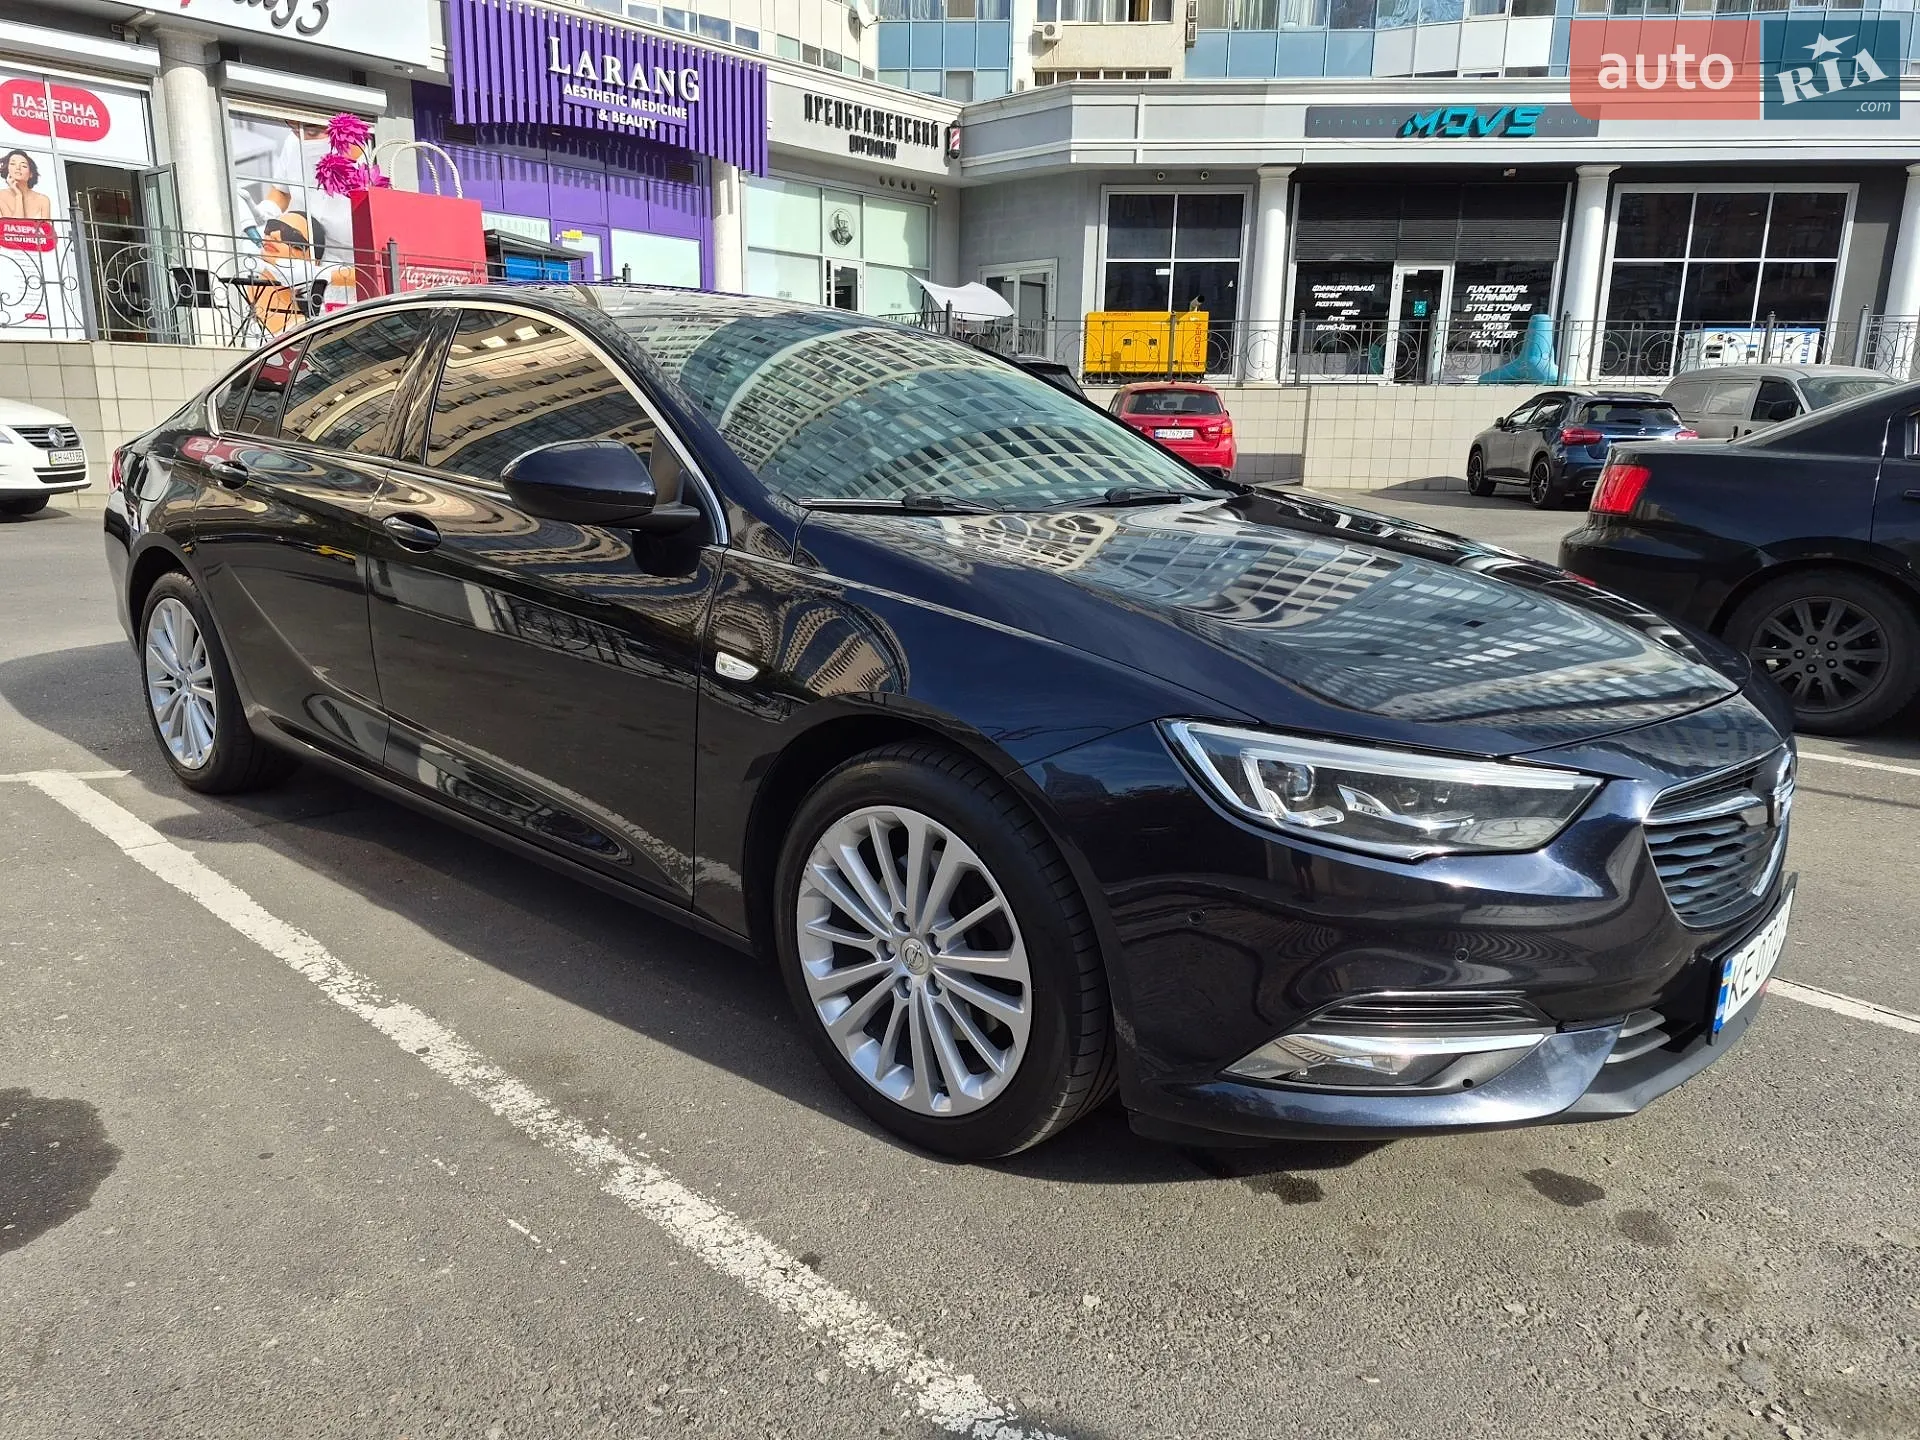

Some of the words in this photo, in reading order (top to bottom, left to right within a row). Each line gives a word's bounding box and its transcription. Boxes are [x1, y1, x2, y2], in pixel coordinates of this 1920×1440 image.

[548, 36, 700, 102] LARANG
[12, 93, 98, 119] ЛАЗЕРНА
[563, 84, 628, 107] AESTHETIC
[631, 98, 688, 120] MEDICINE
[11, 107, 100, 129] КОСМЕТОЛОГІЯ
[599, 109, 609, 122] &
[612, 111, 658, 131] BEAUTY
[1466, 284, 1529, 294] FUNCTIONAL
[1469, 293, 1518, 301] TRAINING
[1464, 303, 1533, 312] STRETCHING
[1473, 313, 1512, 321] BOXING
